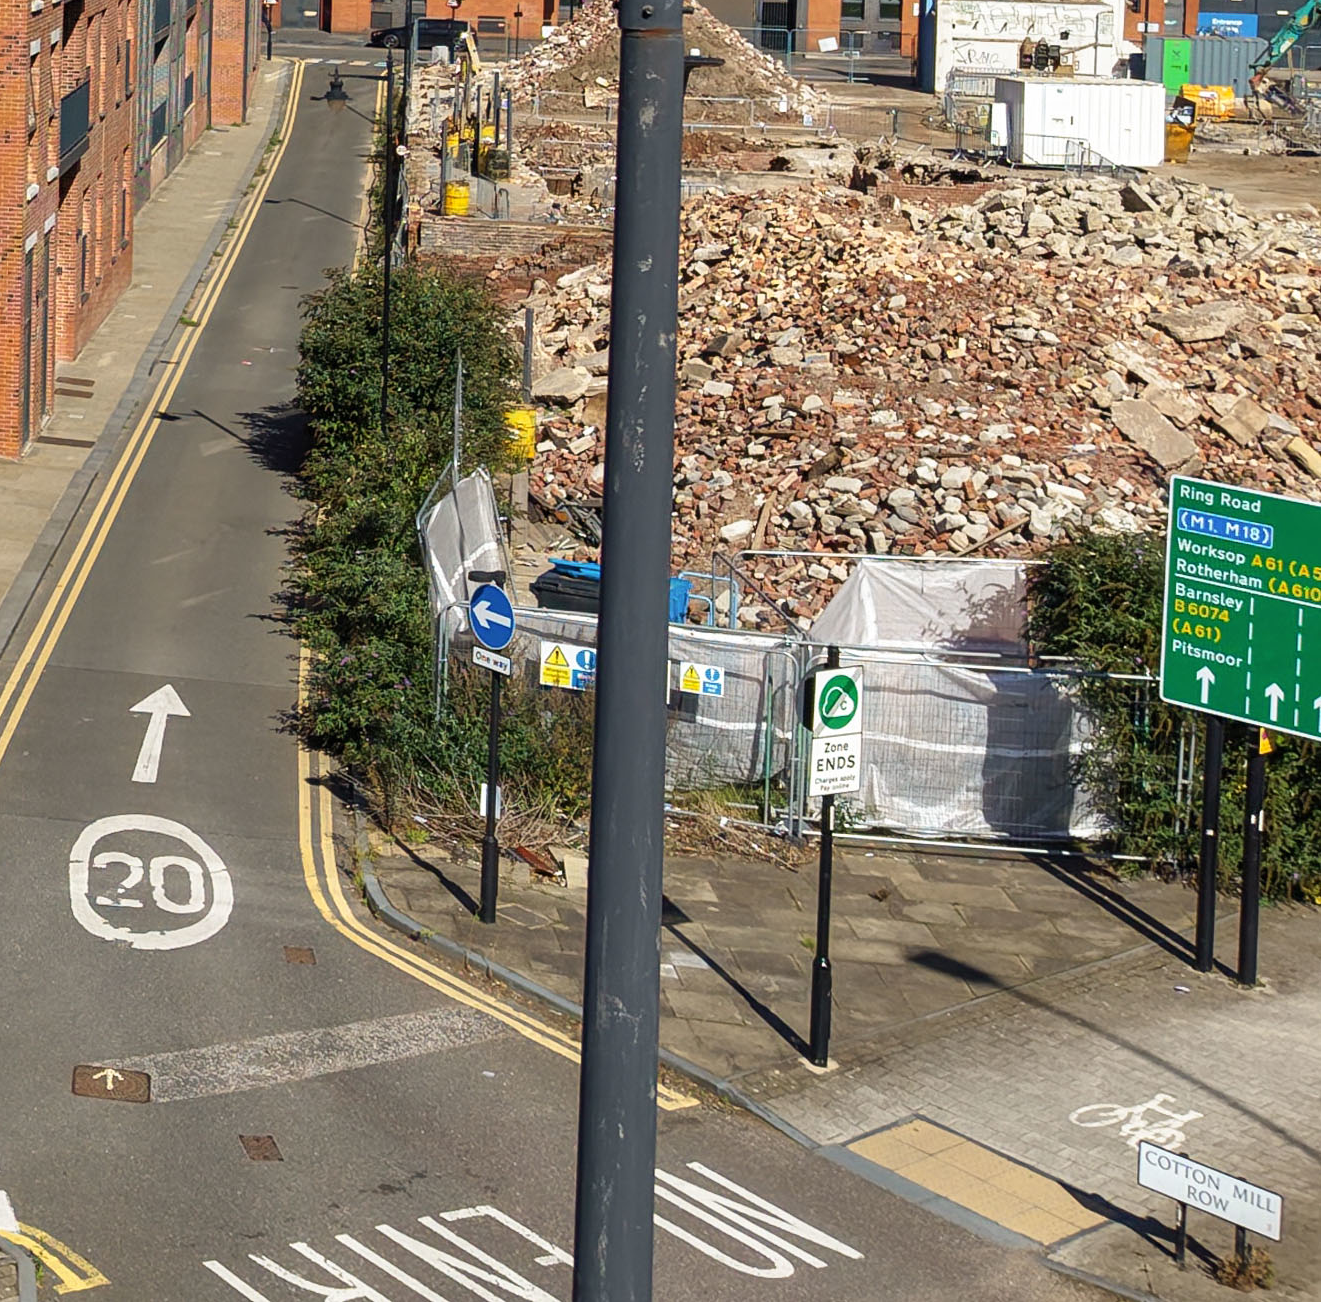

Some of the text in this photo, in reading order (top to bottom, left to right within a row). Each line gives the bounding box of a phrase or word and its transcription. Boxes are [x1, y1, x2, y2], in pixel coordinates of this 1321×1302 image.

[1180, 484, 1261, 513] Ring Road
[1177, 537, 1246, 565] Worksop
[1176, 557, 1262, 589] Rotherham
[1175, 582, 1244, 612] Barnsley
[1172, 639, 1243, 667] Pitsmoor
[840, 700, 847, 710] C
[824, 742, 849, 753] Zone
[816, 755, 856, 772] ENDS
[815, 776, 838, 785] Charges
[92, 851, 205, 914] 20
[1144, 1150, 1275, 1214] COTTON MILL
[1187, 1185, 1229, 1213] ROW
